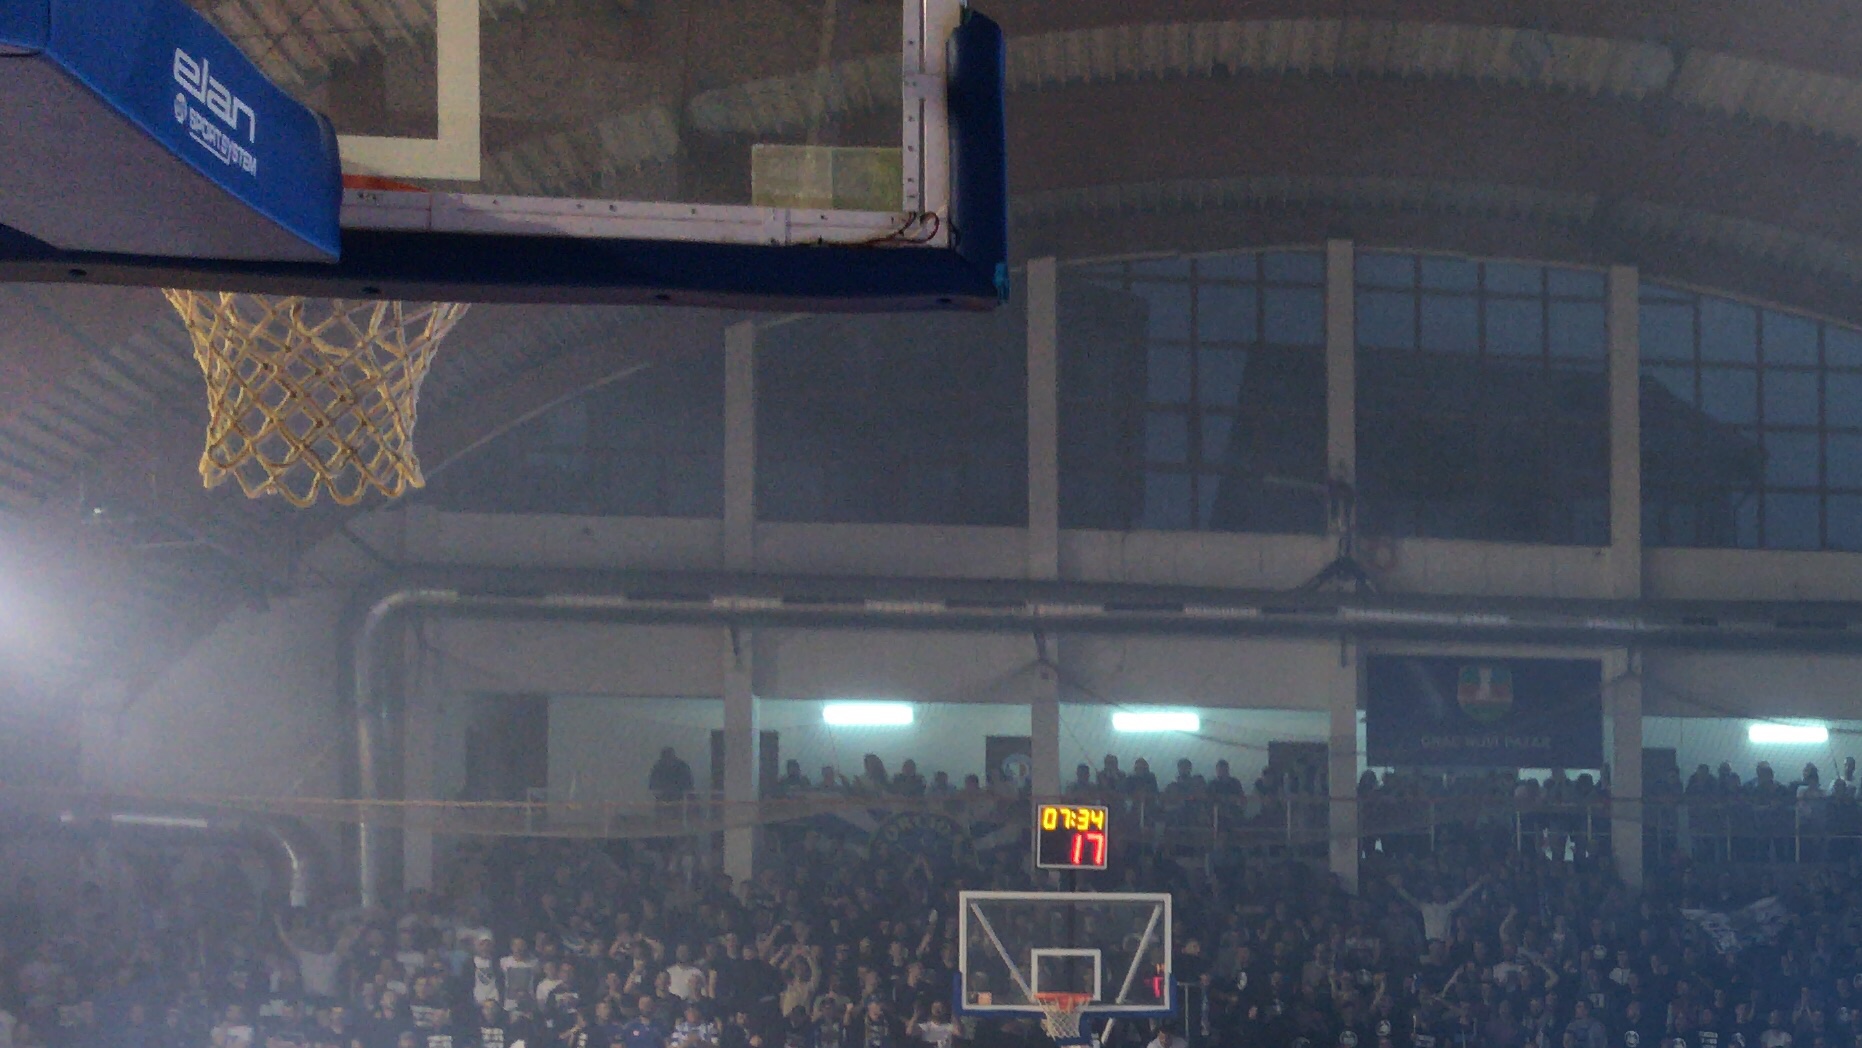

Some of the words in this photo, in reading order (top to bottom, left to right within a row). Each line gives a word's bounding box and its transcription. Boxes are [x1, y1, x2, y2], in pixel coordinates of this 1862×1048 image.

[173, 47, 256, 144] elan
[1042, 806, 1105, 831] 07:34
[1070, 831, 1106, 867] 17
